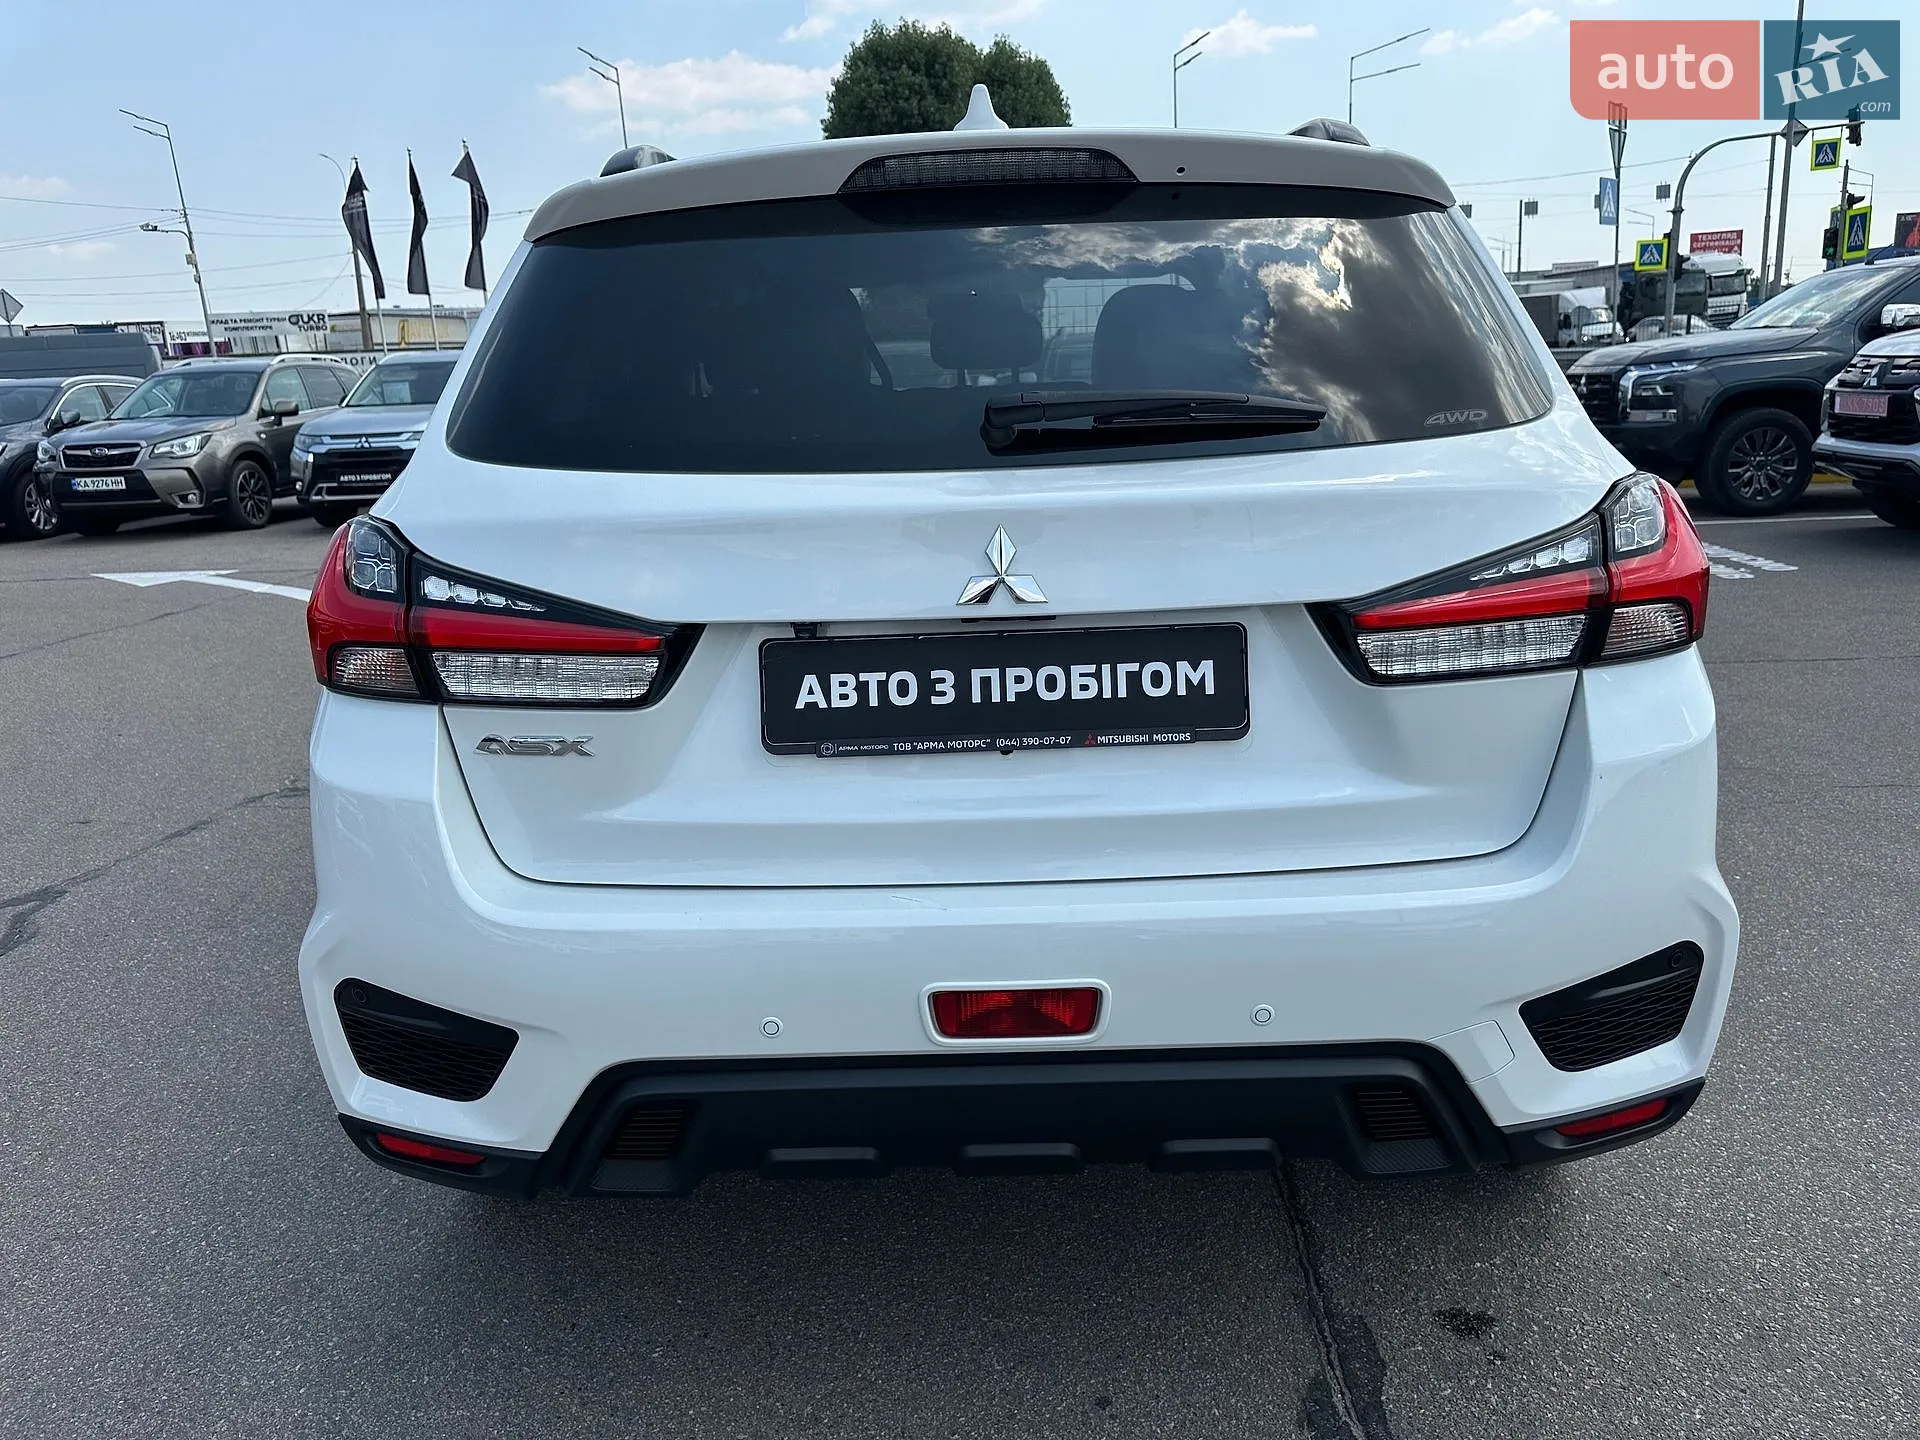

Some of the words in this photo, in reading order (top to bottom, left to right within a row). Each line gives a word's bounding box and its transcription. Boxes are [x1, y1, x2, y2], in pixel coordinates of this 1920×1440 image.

[1698, 232, 1737, 241] ТЕХОГЛЯД
[1424, 408, 1487, 427] 4WD
[91, 479, 109, 488] 9276
[795, 670, 919, 710] АВТО
[970, 659, 1215, 704] ПРОБІГОМ
[474, 734, 595, 757] ASX
[893, 743, 912, 751] ТОВ
[996, 737, 1020, 748] (044)
[1022, 736, 1072, 746] 390-07-07
[1097, 734, 1149, 744] MITSUBISHI
[1153, 733, 1191, 742] MOTORS
